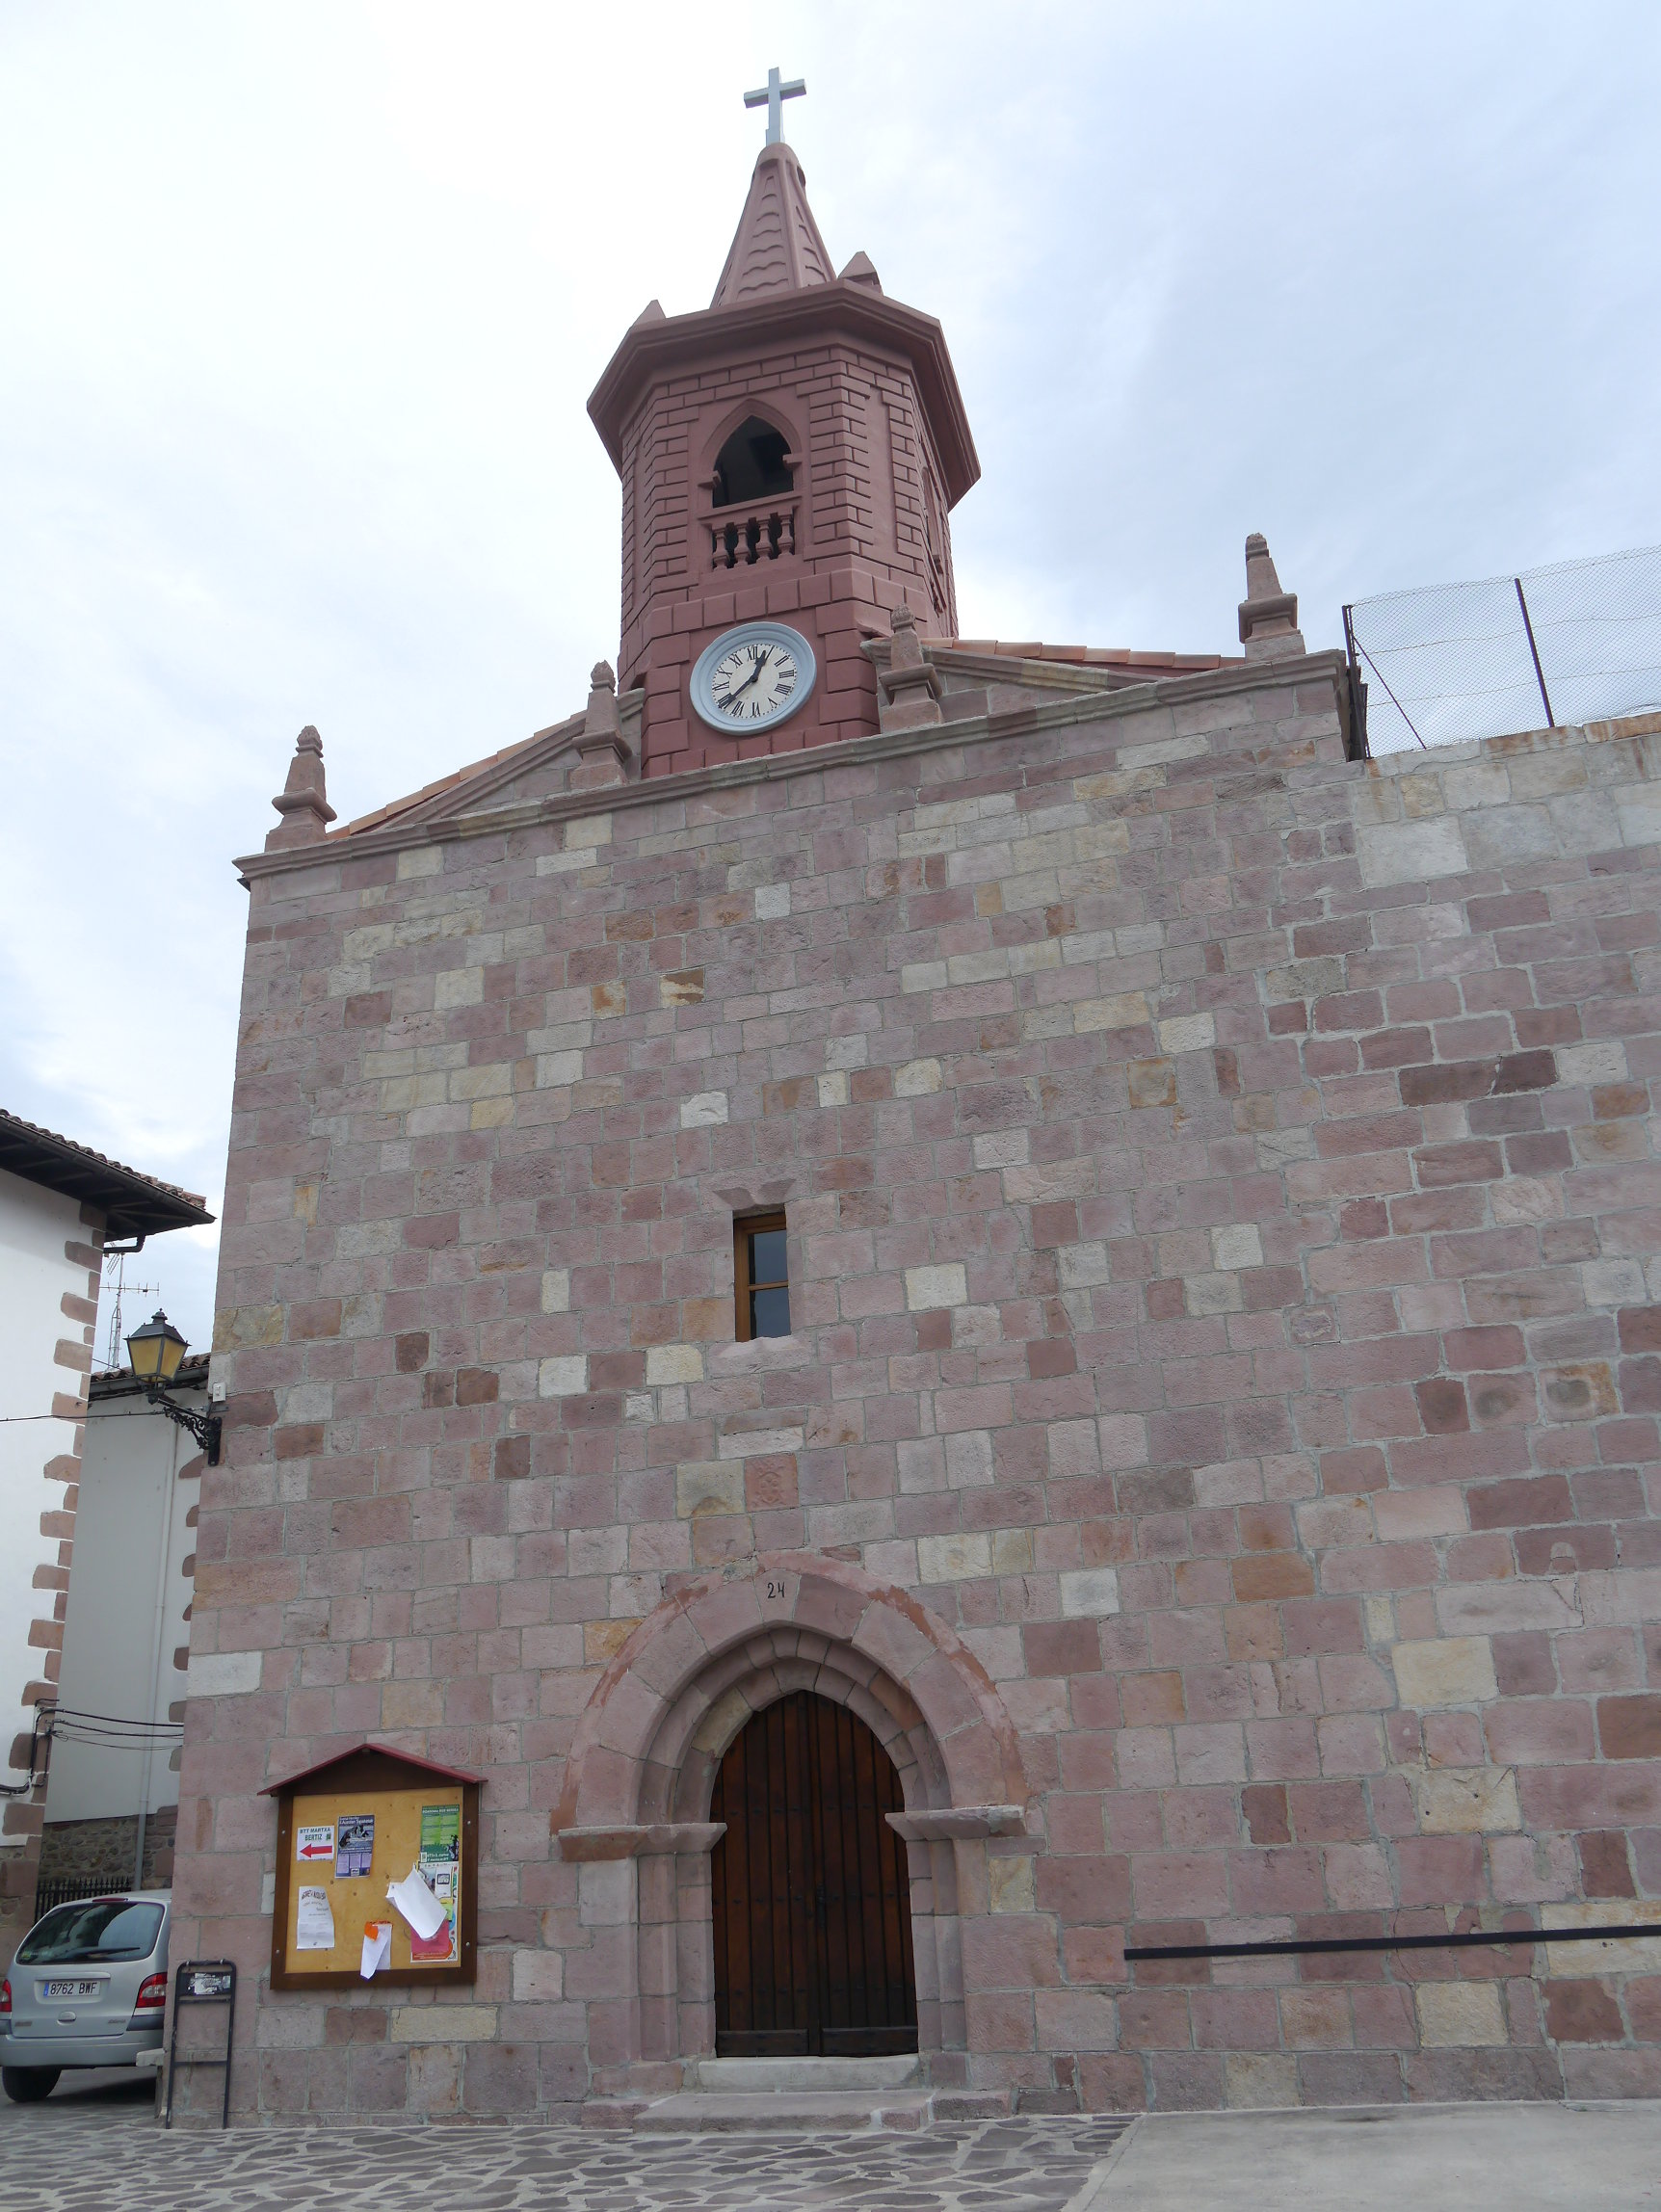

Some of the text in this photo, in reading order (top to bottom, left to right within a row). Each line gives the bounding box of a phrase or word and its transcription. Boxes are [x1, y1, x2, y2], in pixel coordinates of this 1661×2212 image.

[778, 670, 794, 678] III
[767, 1581, 785, 1598] 24
[50, 1982, 97, 1995] 8762 BWF
